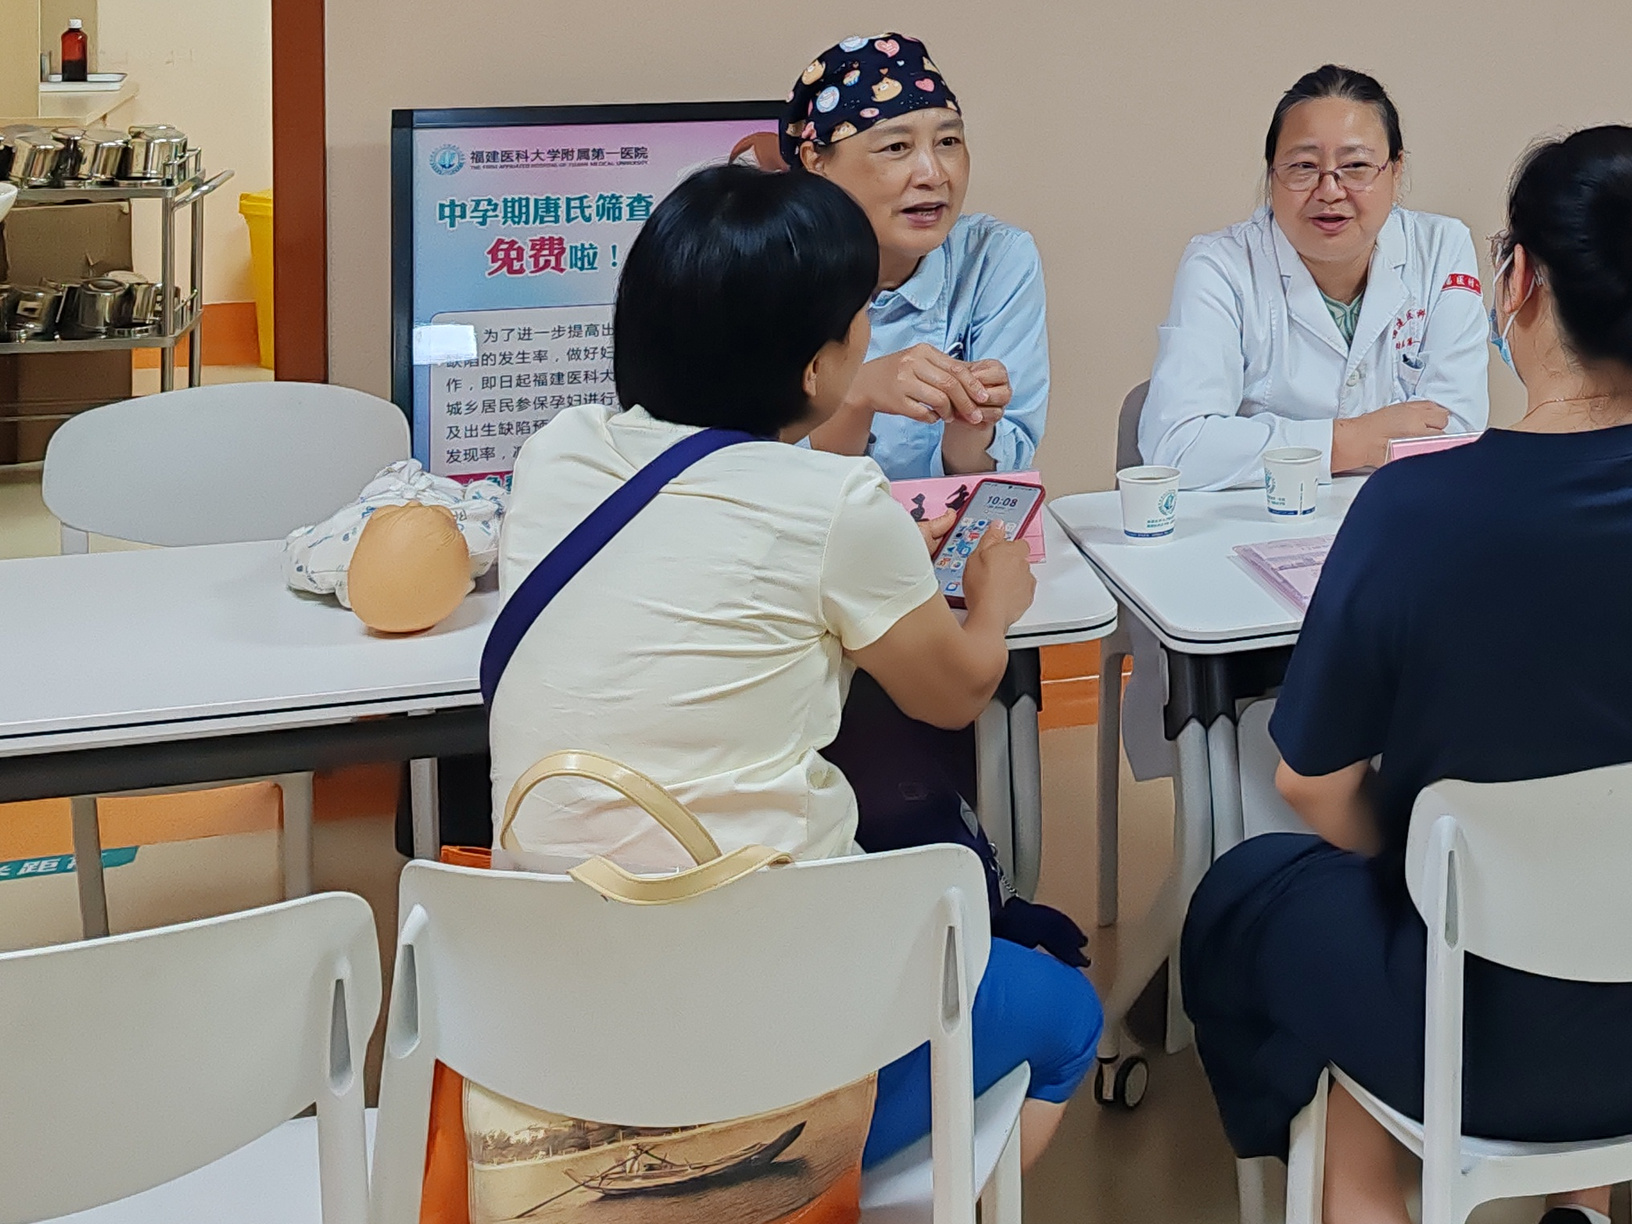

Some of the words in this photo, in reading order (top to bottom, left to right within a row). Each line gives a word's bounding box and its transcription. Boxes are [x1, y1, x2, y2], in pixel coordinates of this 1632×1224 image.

[470, 146, 649, 164] 福建医科大学附属第一医院
[438, 193, 654, 229] 中孕期唐氏筛查
[486, 236, 618, 277] 免费啦！
[483, 323, 615, 344] 为了进一步提高出
[446, 346, 614, 368] 的发生率，做好妇
[446, 369, 615, 393] 作，即日起福建医科大
[446, 392, 621, 416] 城乡居民参保孕妇进行
[987, 495, 1018, 508] 10:08
